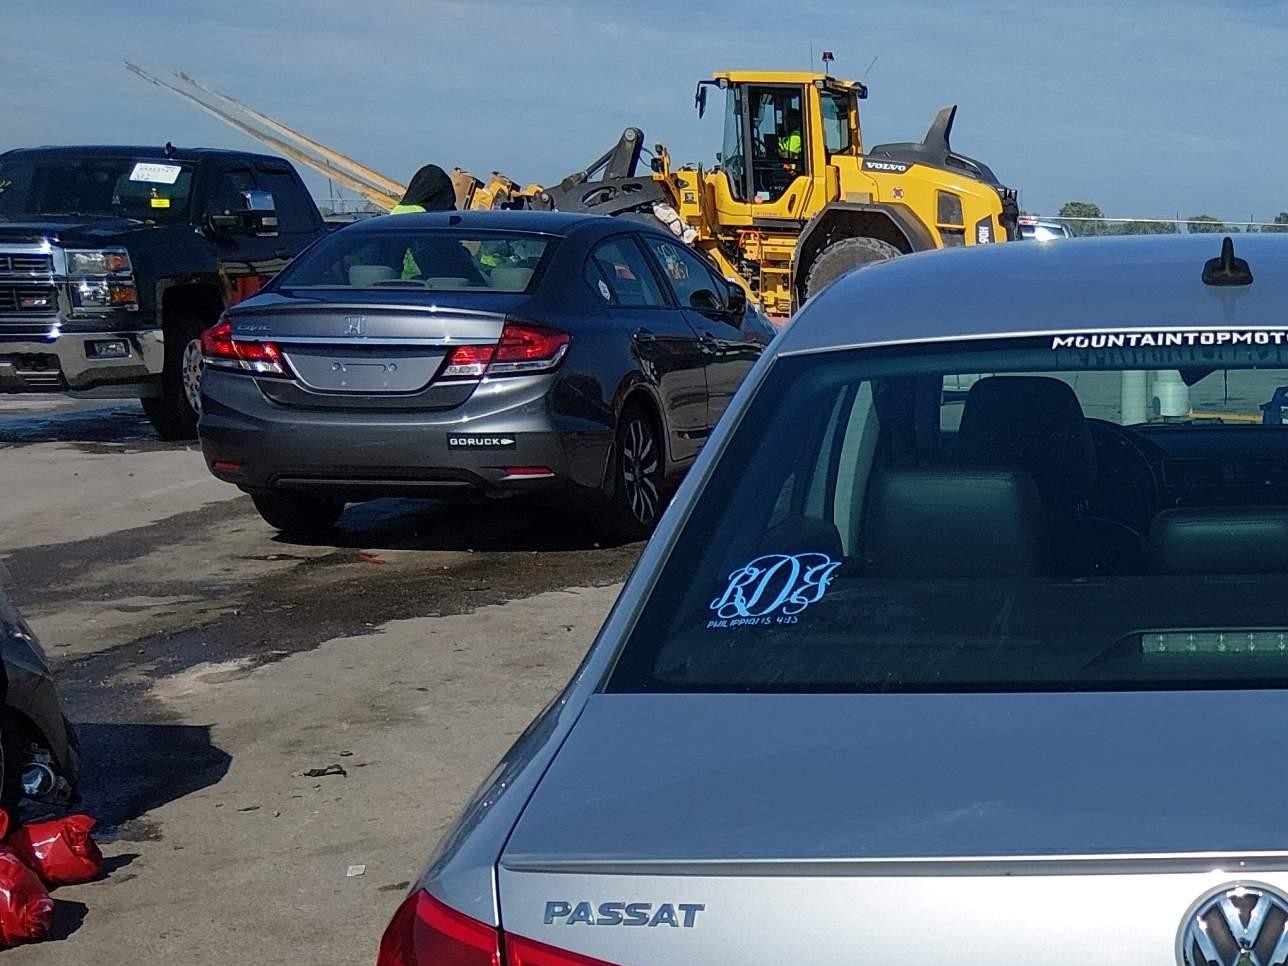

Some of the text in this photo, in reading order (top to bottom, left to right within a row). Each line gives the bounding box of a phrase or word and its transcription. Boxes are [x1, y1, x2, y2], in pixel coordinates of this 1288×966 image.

[866, 162, 906, 172] VOLVO
[449, 438, 501, 447] GORUCK
[543, 901, 706, 928] PASSAT
